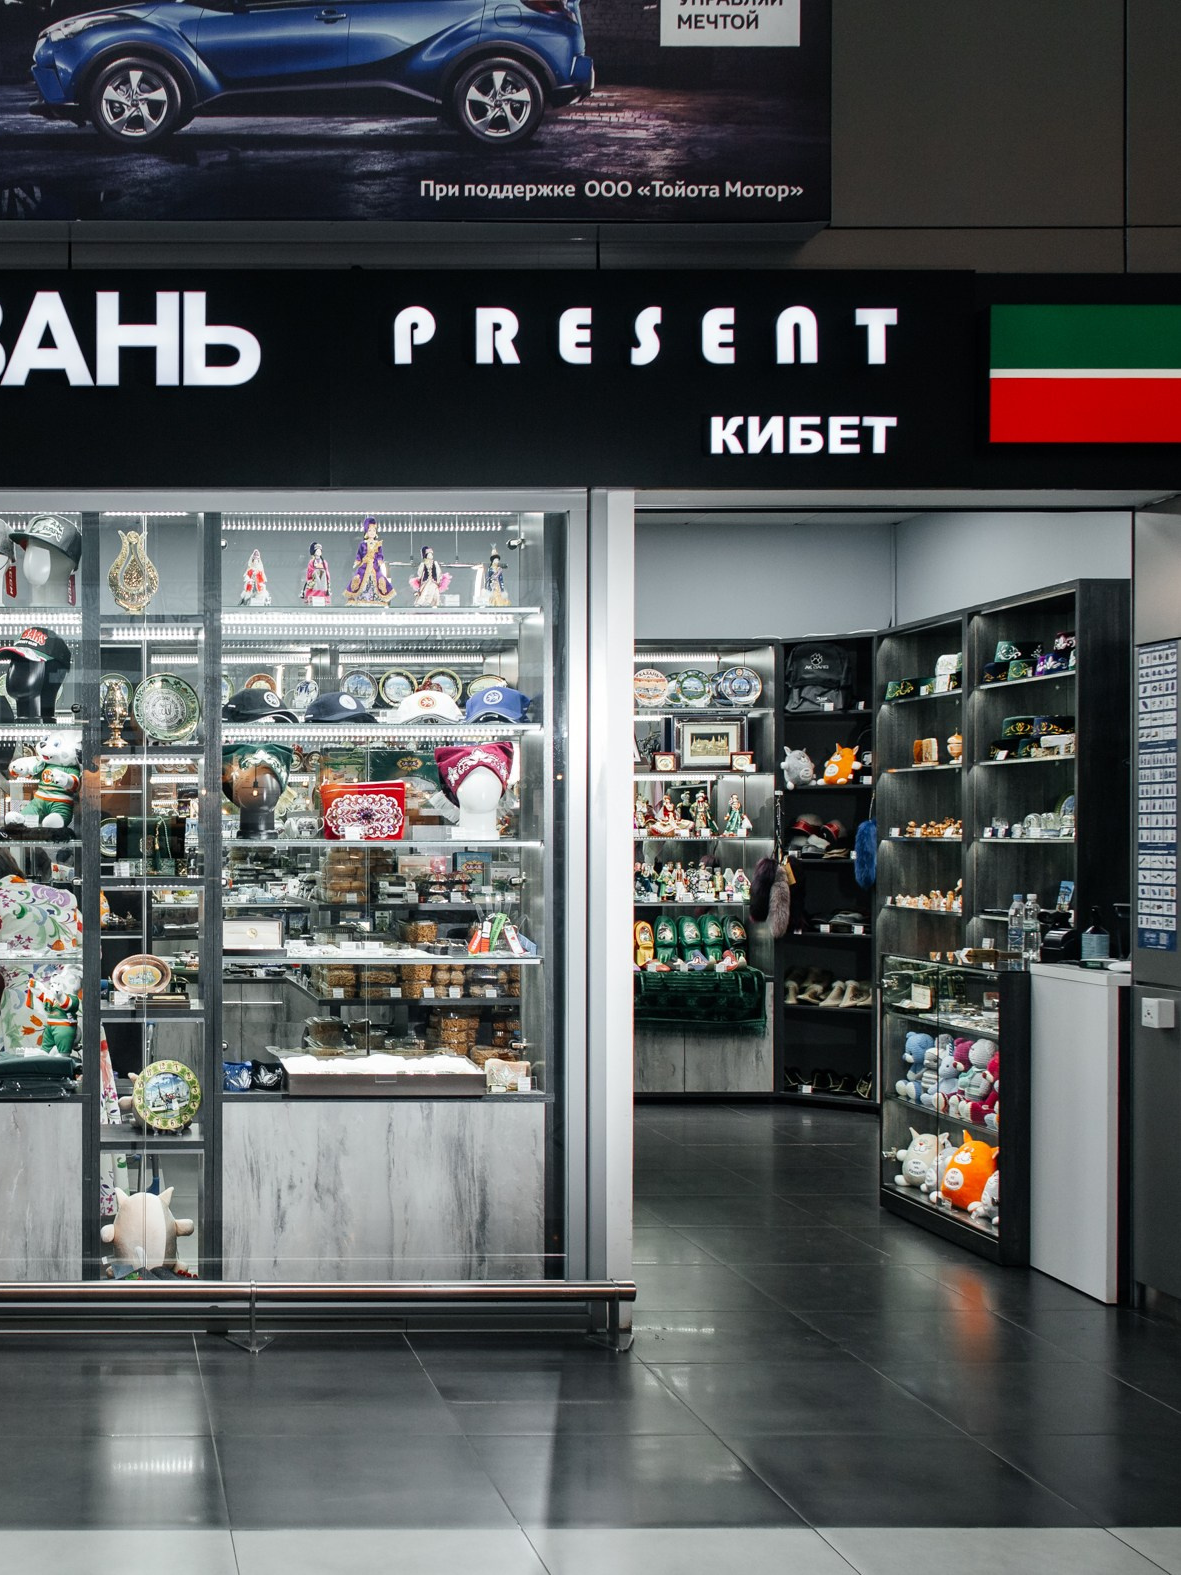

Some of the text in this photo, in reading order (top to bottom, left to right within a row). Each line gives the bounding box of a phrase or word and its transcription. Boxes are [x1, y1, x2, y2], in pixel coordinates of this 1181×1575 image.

[677, 9, 759, 30] МЕЧТОЙ
[420, 180, 804, 201] При поддержке ООО «Тойота Мотор»
[394, 305, 898, 366] PRESENT
[710, 415, 898, 454] КИБЕТ
[21, 628, 48, 646] BARS
